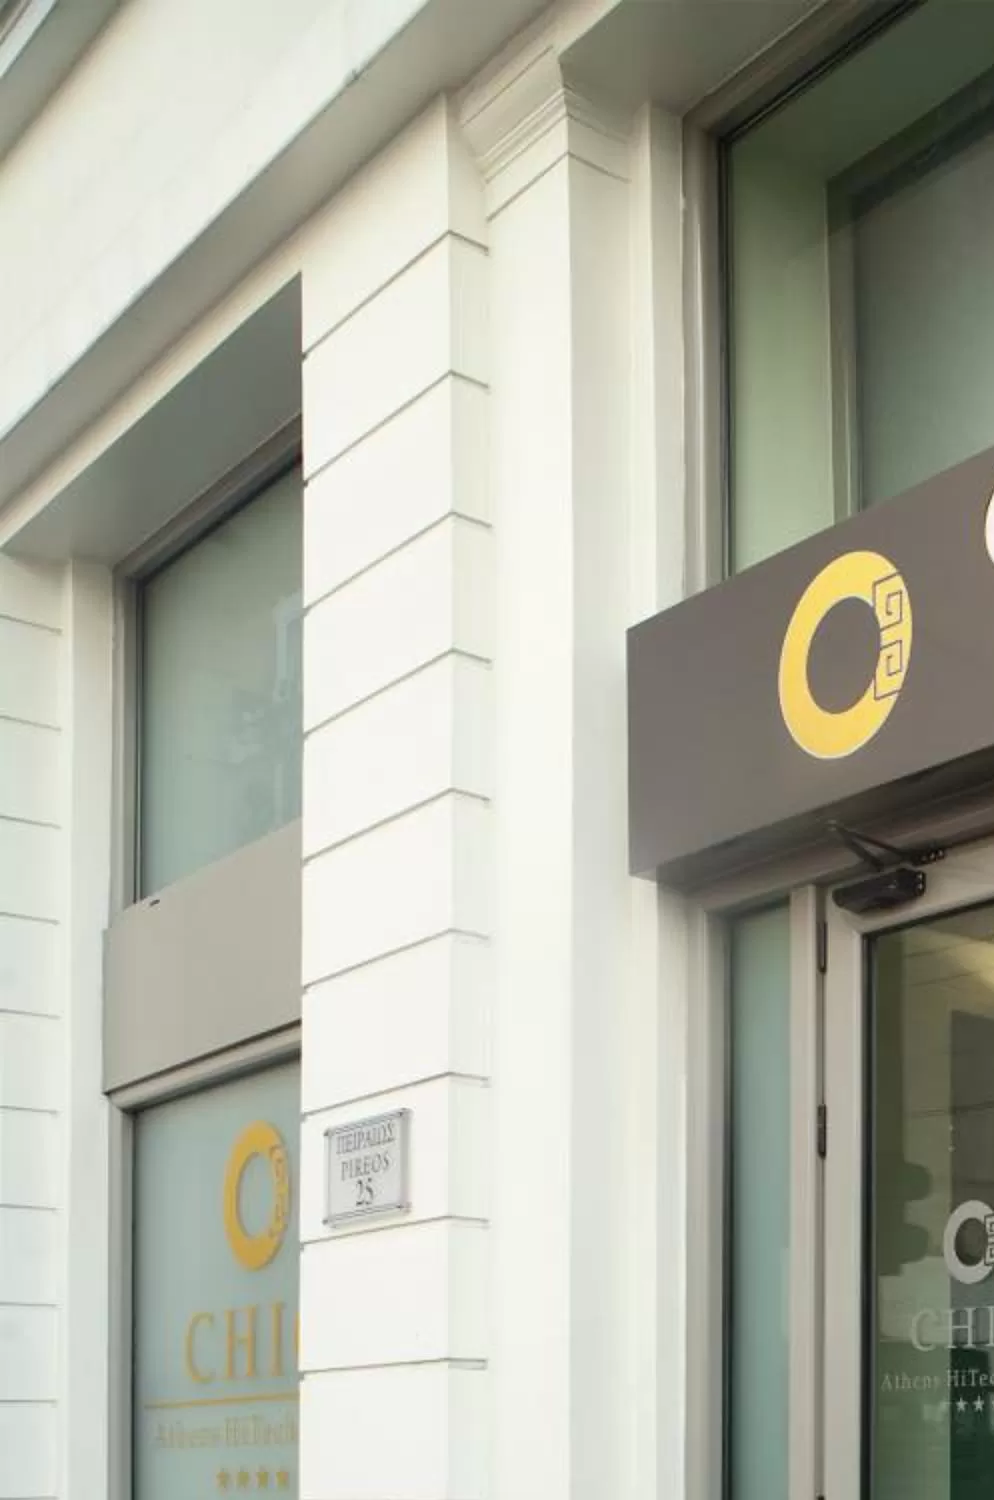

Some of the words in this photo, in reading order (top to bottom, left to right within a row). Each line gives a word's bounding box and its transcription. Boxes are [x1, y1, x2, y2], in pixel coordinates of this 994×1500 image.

[340, 1150, 391, 1181] PIREOS
[353, 1177, 376, 1206] 25
[184, 1301, 299, 1384] CHI
